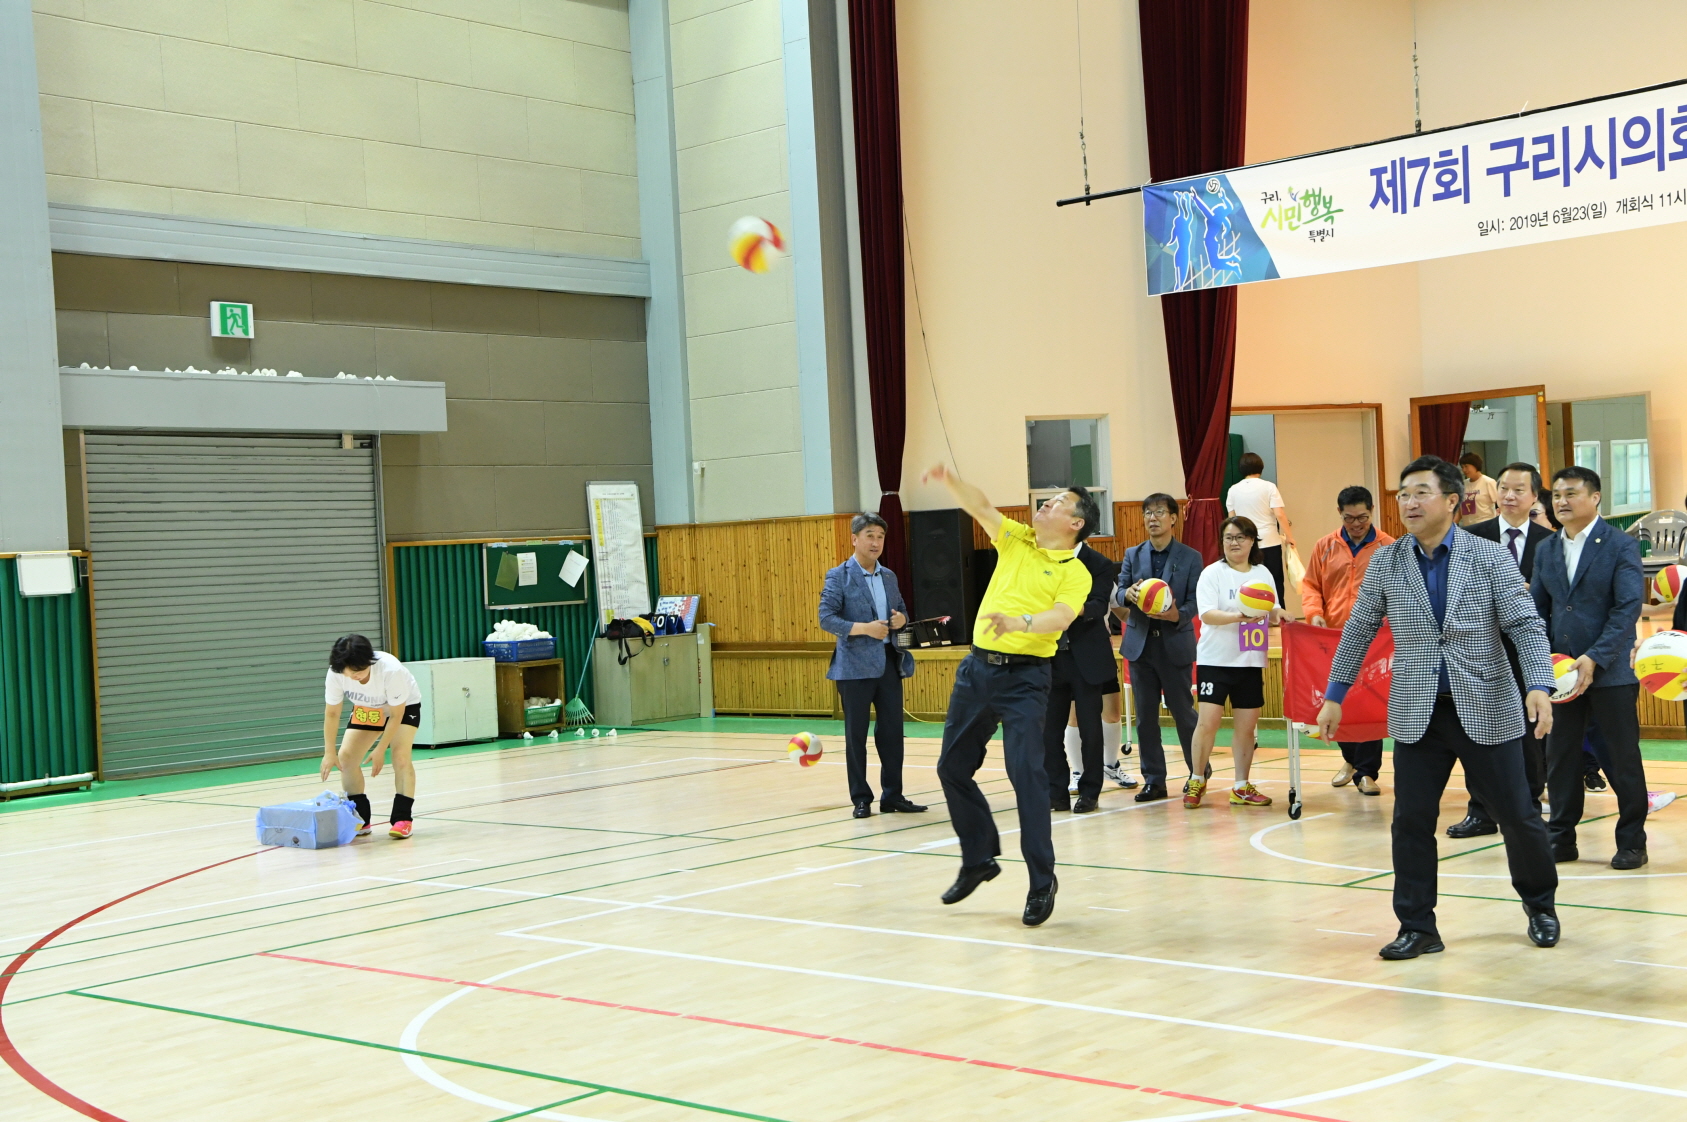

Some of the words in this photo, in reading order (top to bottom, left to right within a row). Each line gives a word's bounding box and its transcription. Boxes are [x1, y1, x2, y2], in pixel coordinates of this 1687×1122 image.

[1369, 145, 1471, 215] 제7회
[1478, 218, 1505, 237] 일시:
[1509, 210, 1548, 231] 2019년
[1552, 200, 1607, 224] 6월23(일)
[1615, 193, 1654, 214] 개회식
[1308, 228, 1335, 243] 특별시
[1242, 628, 1265, 647] 10
[344, 690, 387, 704] MIZUNO
[1200, 682, 1214, 695] 23
